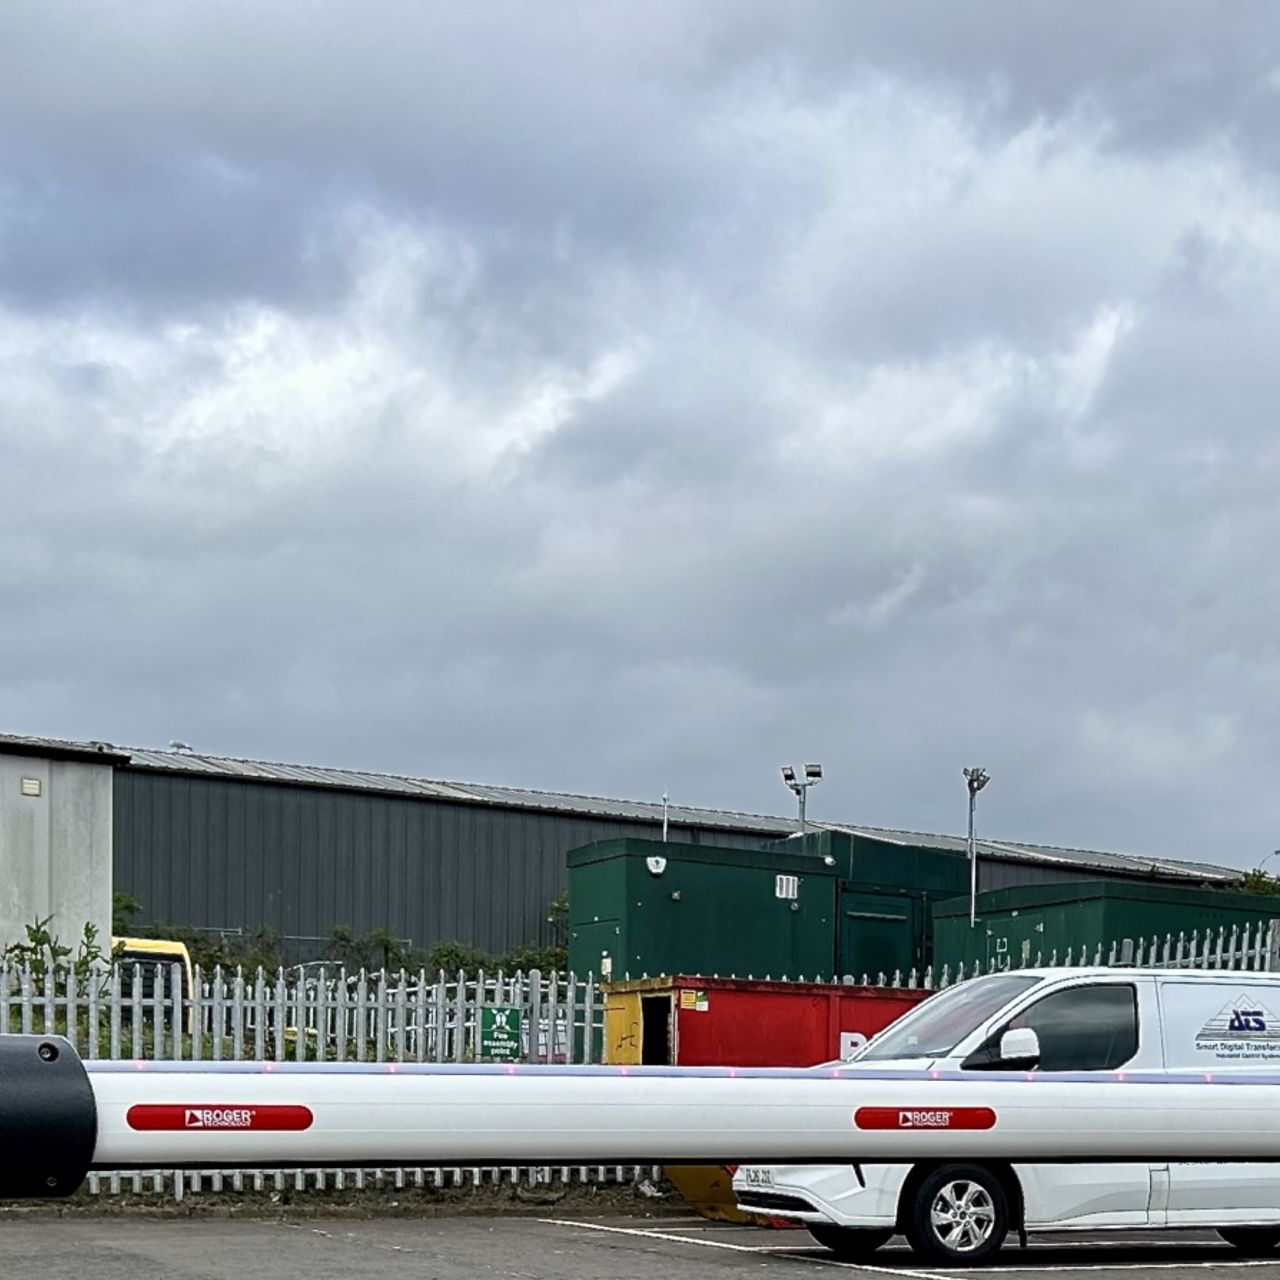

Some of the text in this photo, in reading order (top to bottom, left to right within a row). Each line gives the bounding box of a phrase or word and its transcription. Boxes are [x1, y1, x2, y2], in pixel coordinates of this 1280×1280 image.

[493, 1031, 508, 1039] Fire
[483, 1040, 518, 1049] assembly
[1195, 1043, 1218, 1051] Smart
[1220, 1043, 1244, 1052] Digital
[203, 1109, 251, 1122] ROGER
[913, 1112, 949, 1122] ROGER
